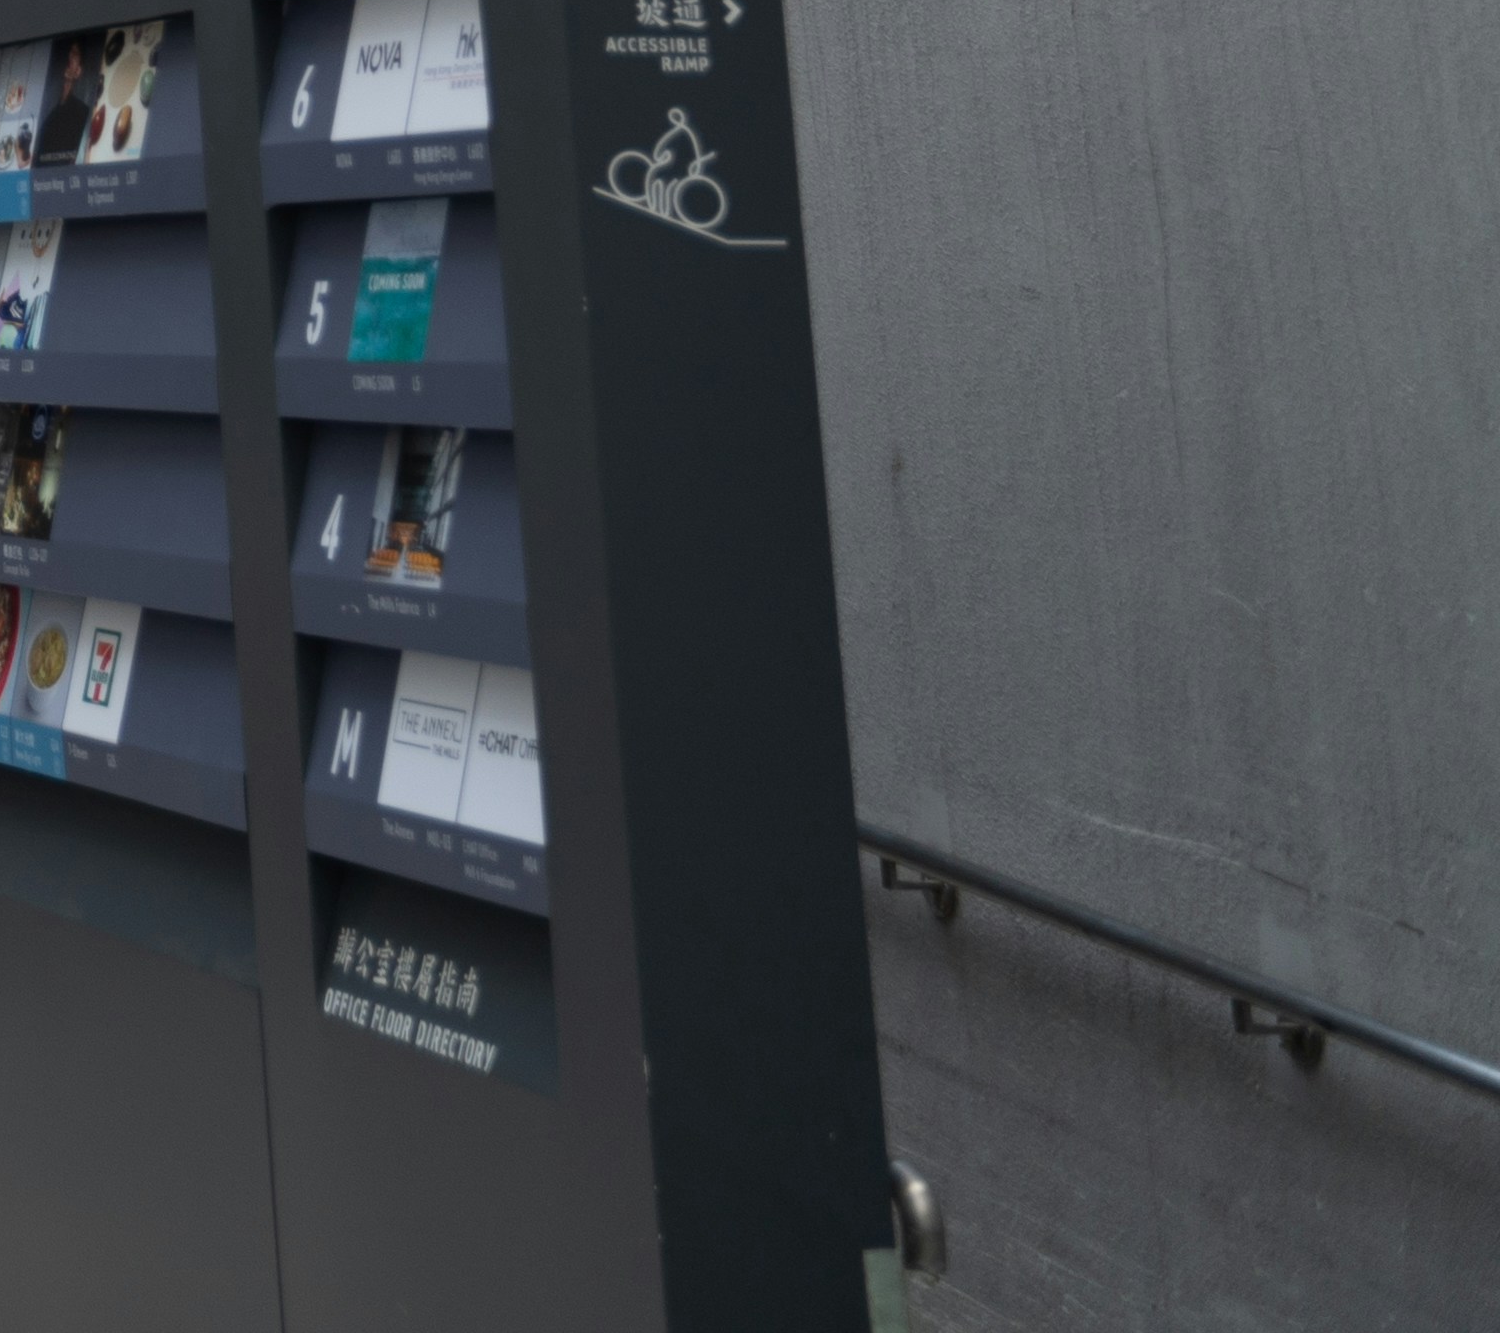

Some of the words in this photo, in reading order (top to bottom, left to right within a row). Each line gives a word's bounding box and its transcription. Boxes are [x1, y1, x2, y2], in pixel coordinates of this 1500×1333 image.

[356, 41, 402, 75] NOVA
[455, 23, 479, 59] hk
[606, 37, 708, 53] ACCESSIBLE
[661, 56, 709, 72] RAMP
[291, 65, 313, 128] 6
[368, 273, 400, 292] COMING
[402, 271, 426, 290] SOON
[306, 280, 329, 345] 5
[320, 494, 344, 560] 4
[331, 709, 361, 778] M
[399, 711, 421, 735] THE
[421, 716, 461, 743] ANNEX
[333, 927, 480, 1017] 辦公室樓層指南
[324, 986, 371, 1027] OFFICE
[370, 1003, 413, 1043] FLOOR
[414, 1018, 499, 1075] DIRECTORY
